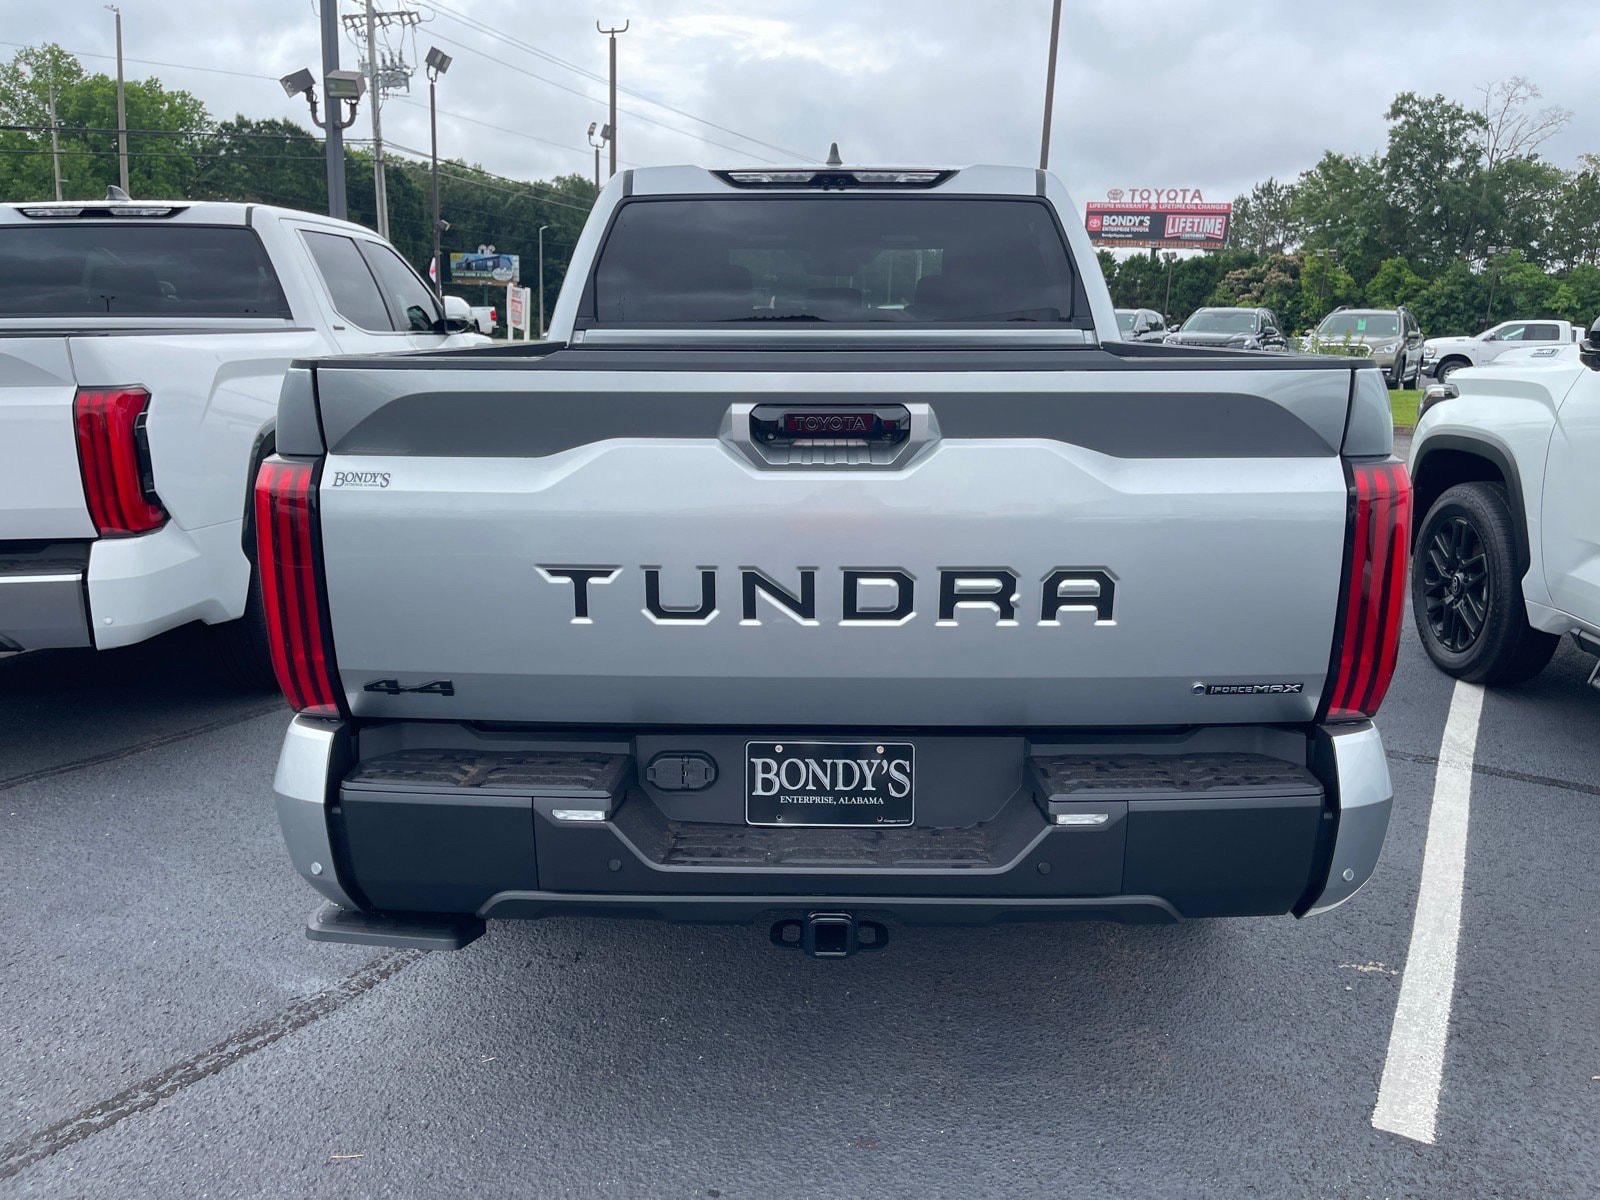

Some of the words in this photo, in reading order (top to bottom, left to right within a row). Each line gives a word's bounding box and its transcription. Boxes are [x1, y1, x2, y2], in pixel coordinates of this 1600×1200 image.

[1128, 188, 1203, 202] TOYOTA
[1102, 215, 1151, 226] BONDY'S
[1167, 217, 1222, 235] LIFETIME
[793, 416, 867, 432] TOYOTA
[332, 471, 391, 488] BONDY'S
[535, 564, 1120, 627] TUNDRA
[750, 757, 911, 798] BONDY'S
[779, 795, 837, 805] ENTERPRISE,
[838, 796, 885, 805] ALABAMA
